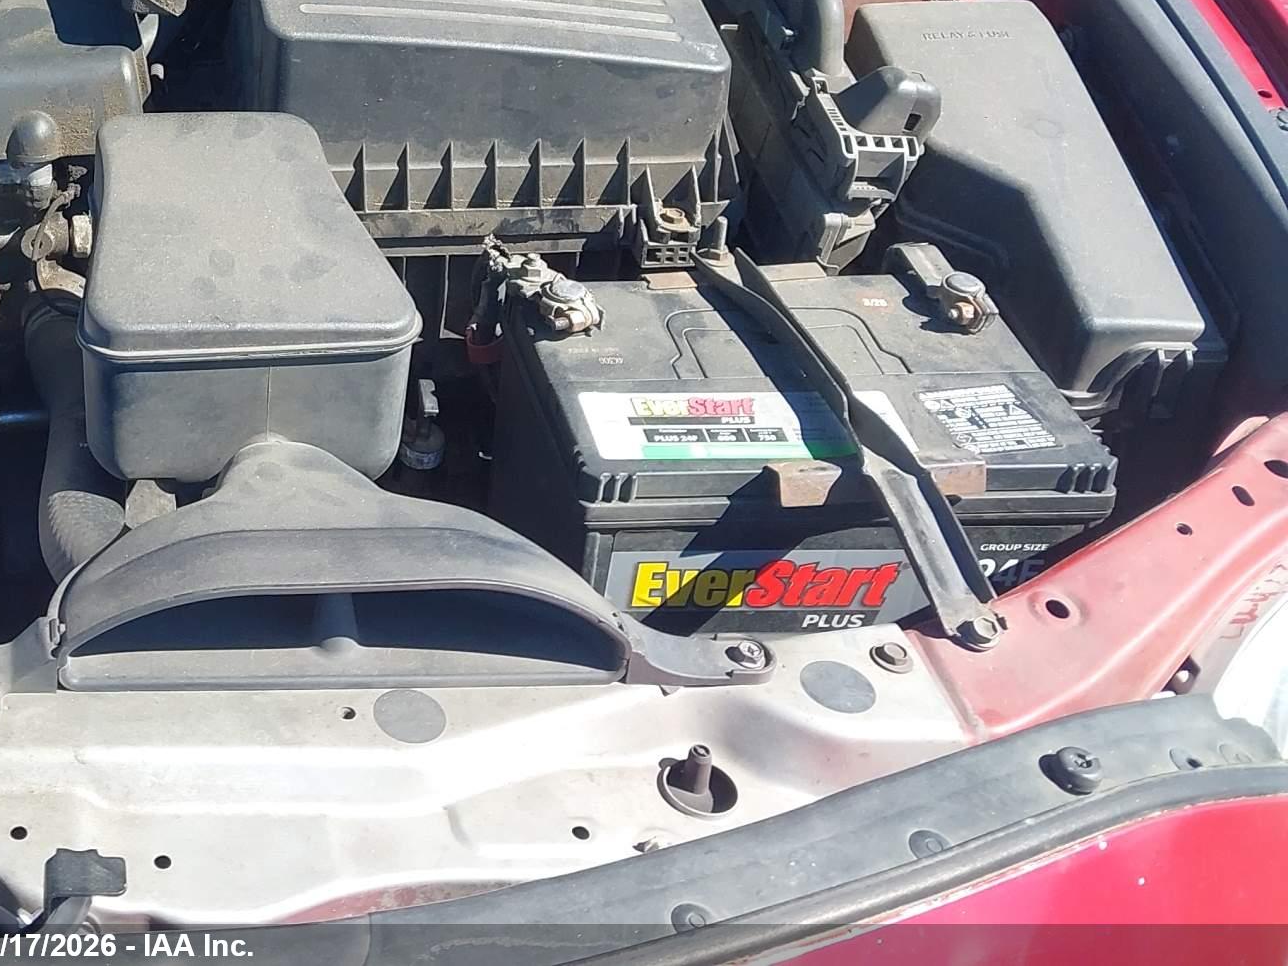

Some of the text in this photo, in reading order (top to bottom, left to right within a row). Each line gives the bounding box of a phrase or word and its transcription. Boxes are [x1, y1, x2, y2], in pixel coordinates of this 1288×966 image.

[921, 30, 963, 41] RELAY
[630, 397, 754, 417] EverStart
[980, 543, 1050, 552] GROUP SIZE
[630, 560, 903, 609] EverStart
[802, 614, 865, 629] PLUS
